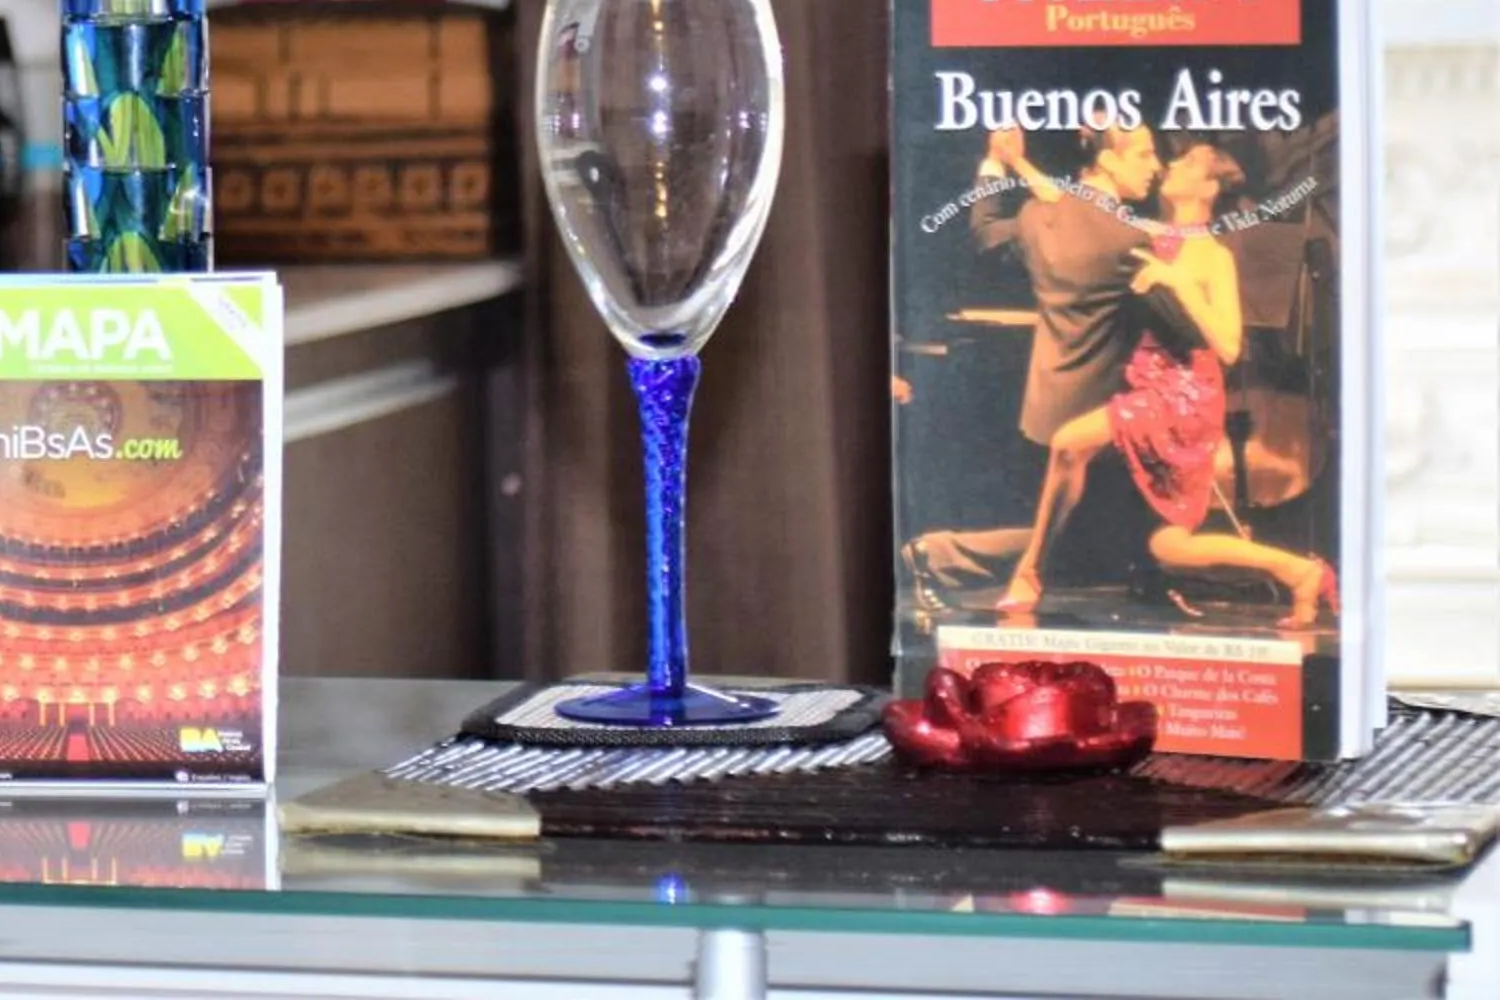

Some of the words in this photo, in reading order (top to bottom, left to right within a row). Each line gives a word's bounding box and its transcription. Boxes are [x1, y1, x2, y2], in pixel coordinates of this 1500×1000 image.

[1045, 4, 1196, 37] Português
[934, 69, 1141, 131] Buenos
[1160, 67, 1303, 131] Aires
[920, 201, 960, 234] Com
[1221, 209, 1261, 233] Vida
